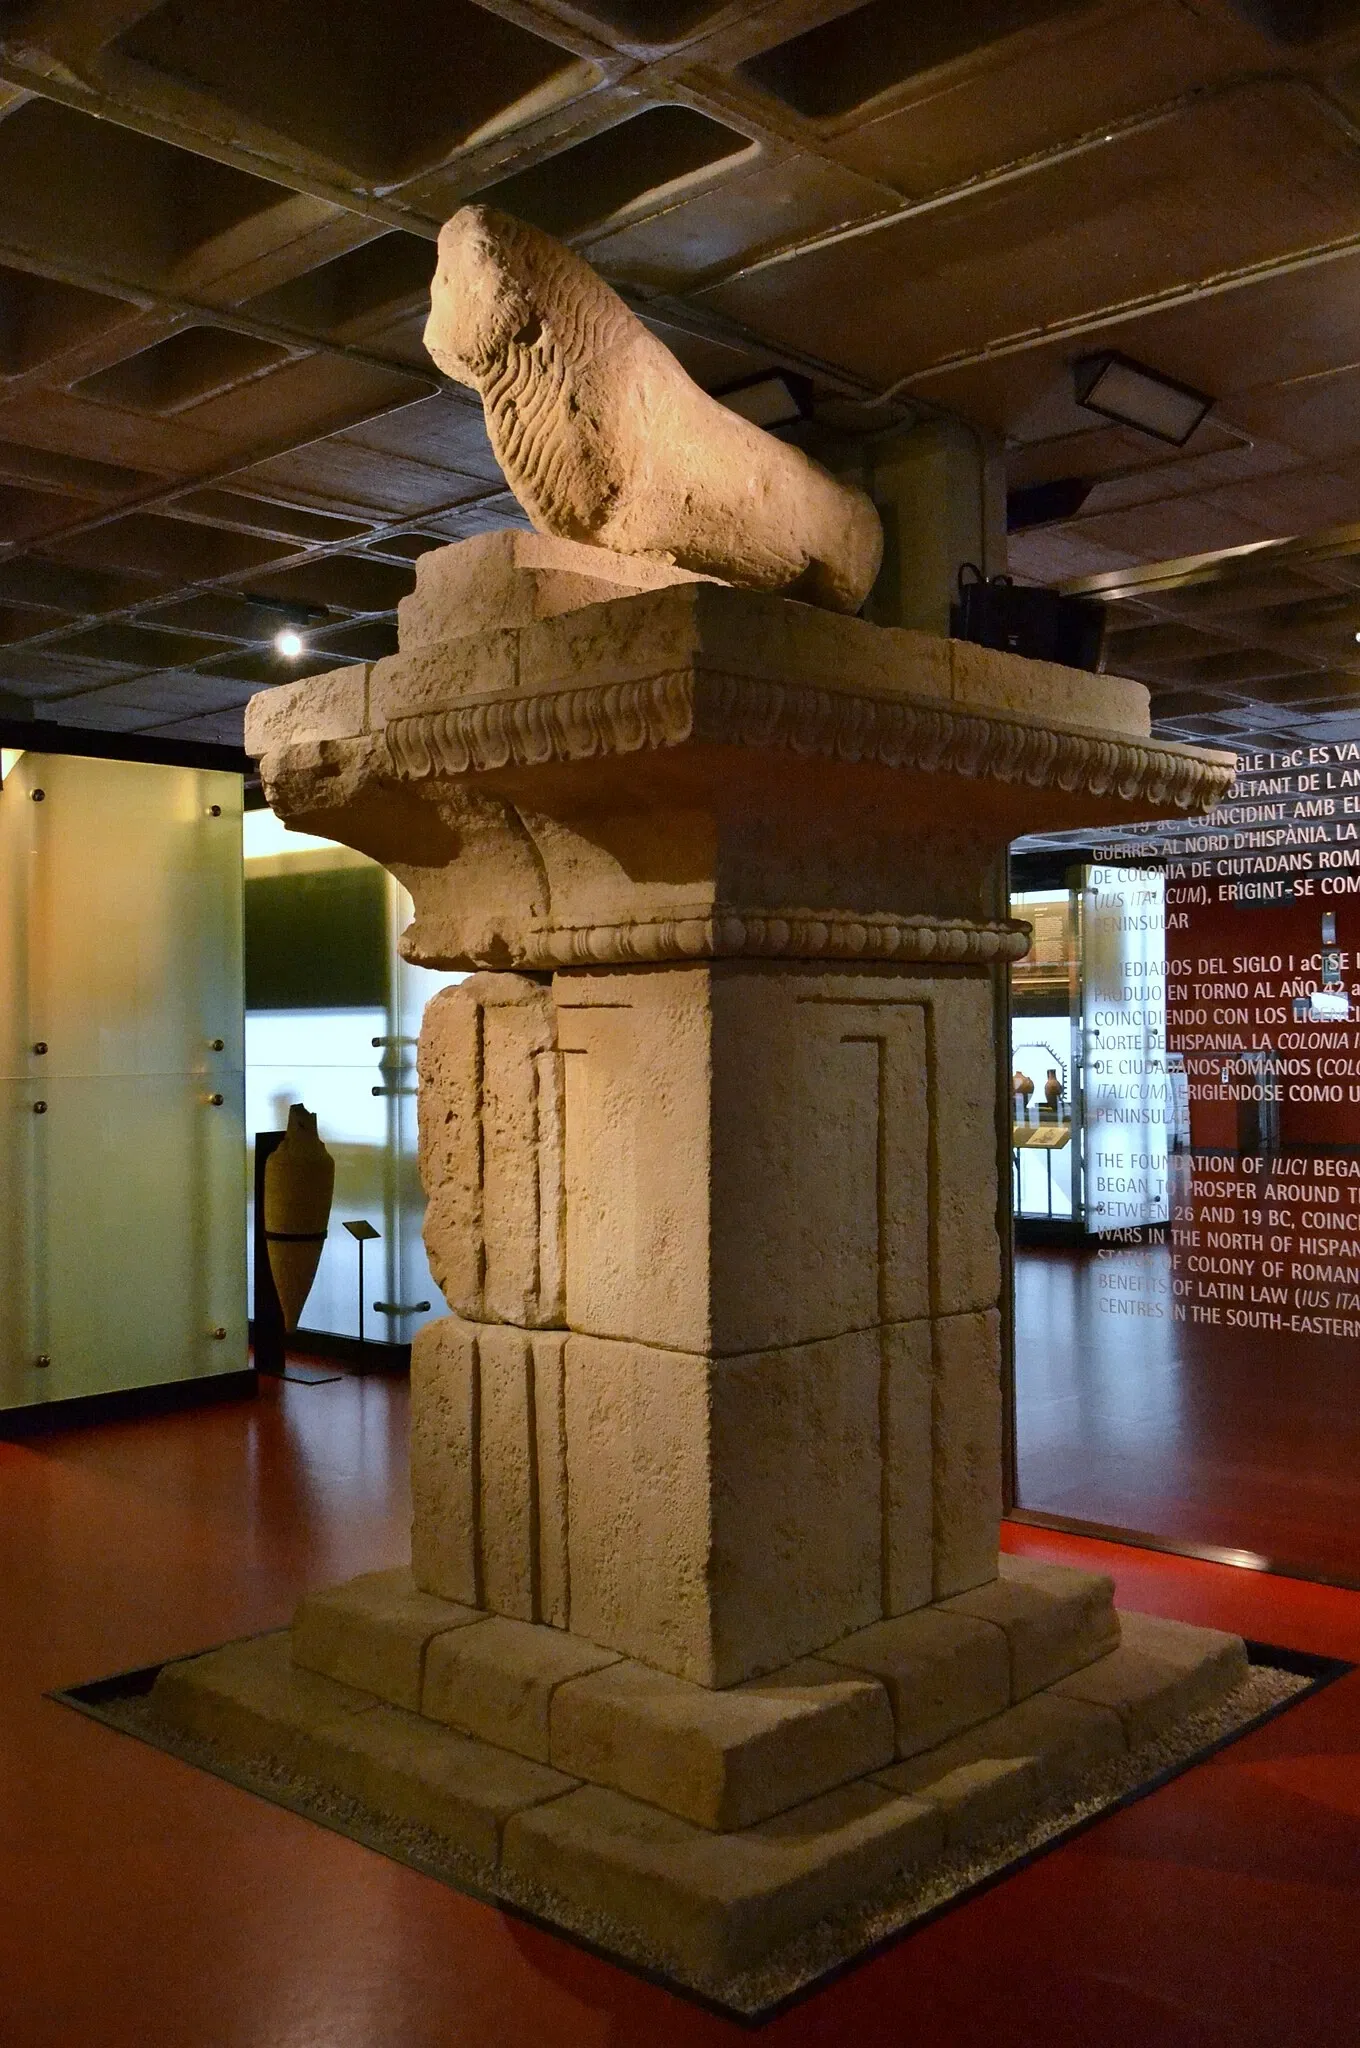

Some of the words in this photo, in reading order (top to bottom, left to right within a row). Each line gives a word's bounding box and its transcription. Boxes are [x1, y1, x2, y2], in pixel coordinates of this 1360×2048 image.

[1234, 754, 1264, 773] GLE
[1281, 750, 1303, 768] aC
[1309, 746, 1330, 765] ES
[1221, 776, 1292, 799] OLTANT
[1298, 773, 1320, 792] DE
[1187, 803, 1287, 828] COINCIDINT
[1293, 798, 1335, 818] AMB
[1092, 840, 1158, 861] GUERRES
[1162, 838, 1182, 855] AL
[1185, 835, 1229, 854] NORD
[1234, 823, 1332, 849] D'HISPÀNIA.
[1336, 822, 1358, 841] LA
[1094, 869, 1112, 885] DE
[1118, 862, 1186, 883] COLONIA
[1191, 861, 1211, 878] DE
[1217, 852, 1313, 876] CIUTADANS
[1319, 849, 1360, 869] ROM
[1218, 878, 1315, 902] ERIGINT-SE
[1094, 912, 1190, 933] PENINSULAR
[1198, 958, 1228, 975] DEL
[1232, 955, 1282, 974] SIGLO
[1300, 953, 1322, 971] aC
[1328, 952, 1350, 970] SE
[1168, 984, 1188, 1001] EN
[1192, 982, 1249, 1000] TORNO
[1253, 981, 1275, 998] AL
[1279, 976, 1318, 998] AÑO
[1094, 1009, 1207, 1027] COINCIDIENDO
[1213, 1007, 1249, 1025] CON
[1255, 1007, 1287, 1024] LOS
[1095, 1034, 1142, 1051] NORTE
[1147, 1034, 1165, 1050] DE
[1170, 1033, 1248, 1051] HISPANIA.
[1252, 1033, 1272, 1050] LA
[1277, 1032, 1349, 1050] COLONIA
[1096, 1059, 1113, 1075] DE
[1119, 1059, 1220, 1076] CIUDADANOS
[1225, 1058, 1311, 1076] ROMANOS
[1178, 1083, 1284, 1101] ERIGIENDOSE
[1289, 1085, 1343, 1102] COMO
[1096, 1152, 1124, 1169] THE
[1130, 1153, 1235, 1173] FOUNDATION
[1242, 1156, 1264, 1174] OF
[1271, 1158, 1307, 1176] ILICI
[1097, 1176, 1148, 1194] BEGAN
[1156, 1179, 1177, 1196] TO
[1183, 1180, 1257, 1199] PROSPER
[1264, 1183, 1340, 1203] AROUND
[1347, 1187, 1360, 1204] T
[1096, 1201, 1168, 1220] BETWEEN
[1174, 1205, 1194, 1222] 26
[1199, 1206, 1235, 1224] AND
[1242, 1209, 1262, 1226] 19
[1268, 1209, 1296, 1230] BC,
[1096, 1225, 1142, 1244] WARS
[1148, 1227, 1165, 1245] IN
[1170, 1229, 1201, 1247] THE
[1207, 1231, 1264, 1251] NORTH
[1270, 1235, 1292, 1253] OF
[1187, 1254, 1255, 1276] COLONY
[1262, 1260, 1284, 1278] OF
[1098, 1272, 1168, 1294] BENEFITS
[1172, 1278, 1193, 1296] OF
[1198, 1281, 1244, 1301] LATIN
[1250, 1285, 1288, 1305] LAW
[1294, 1287, 1331, 1309] (IUS
[1098, 1296, 1164, 1319] CENTRES
[1190, 1305, 1221, 1324] THE
